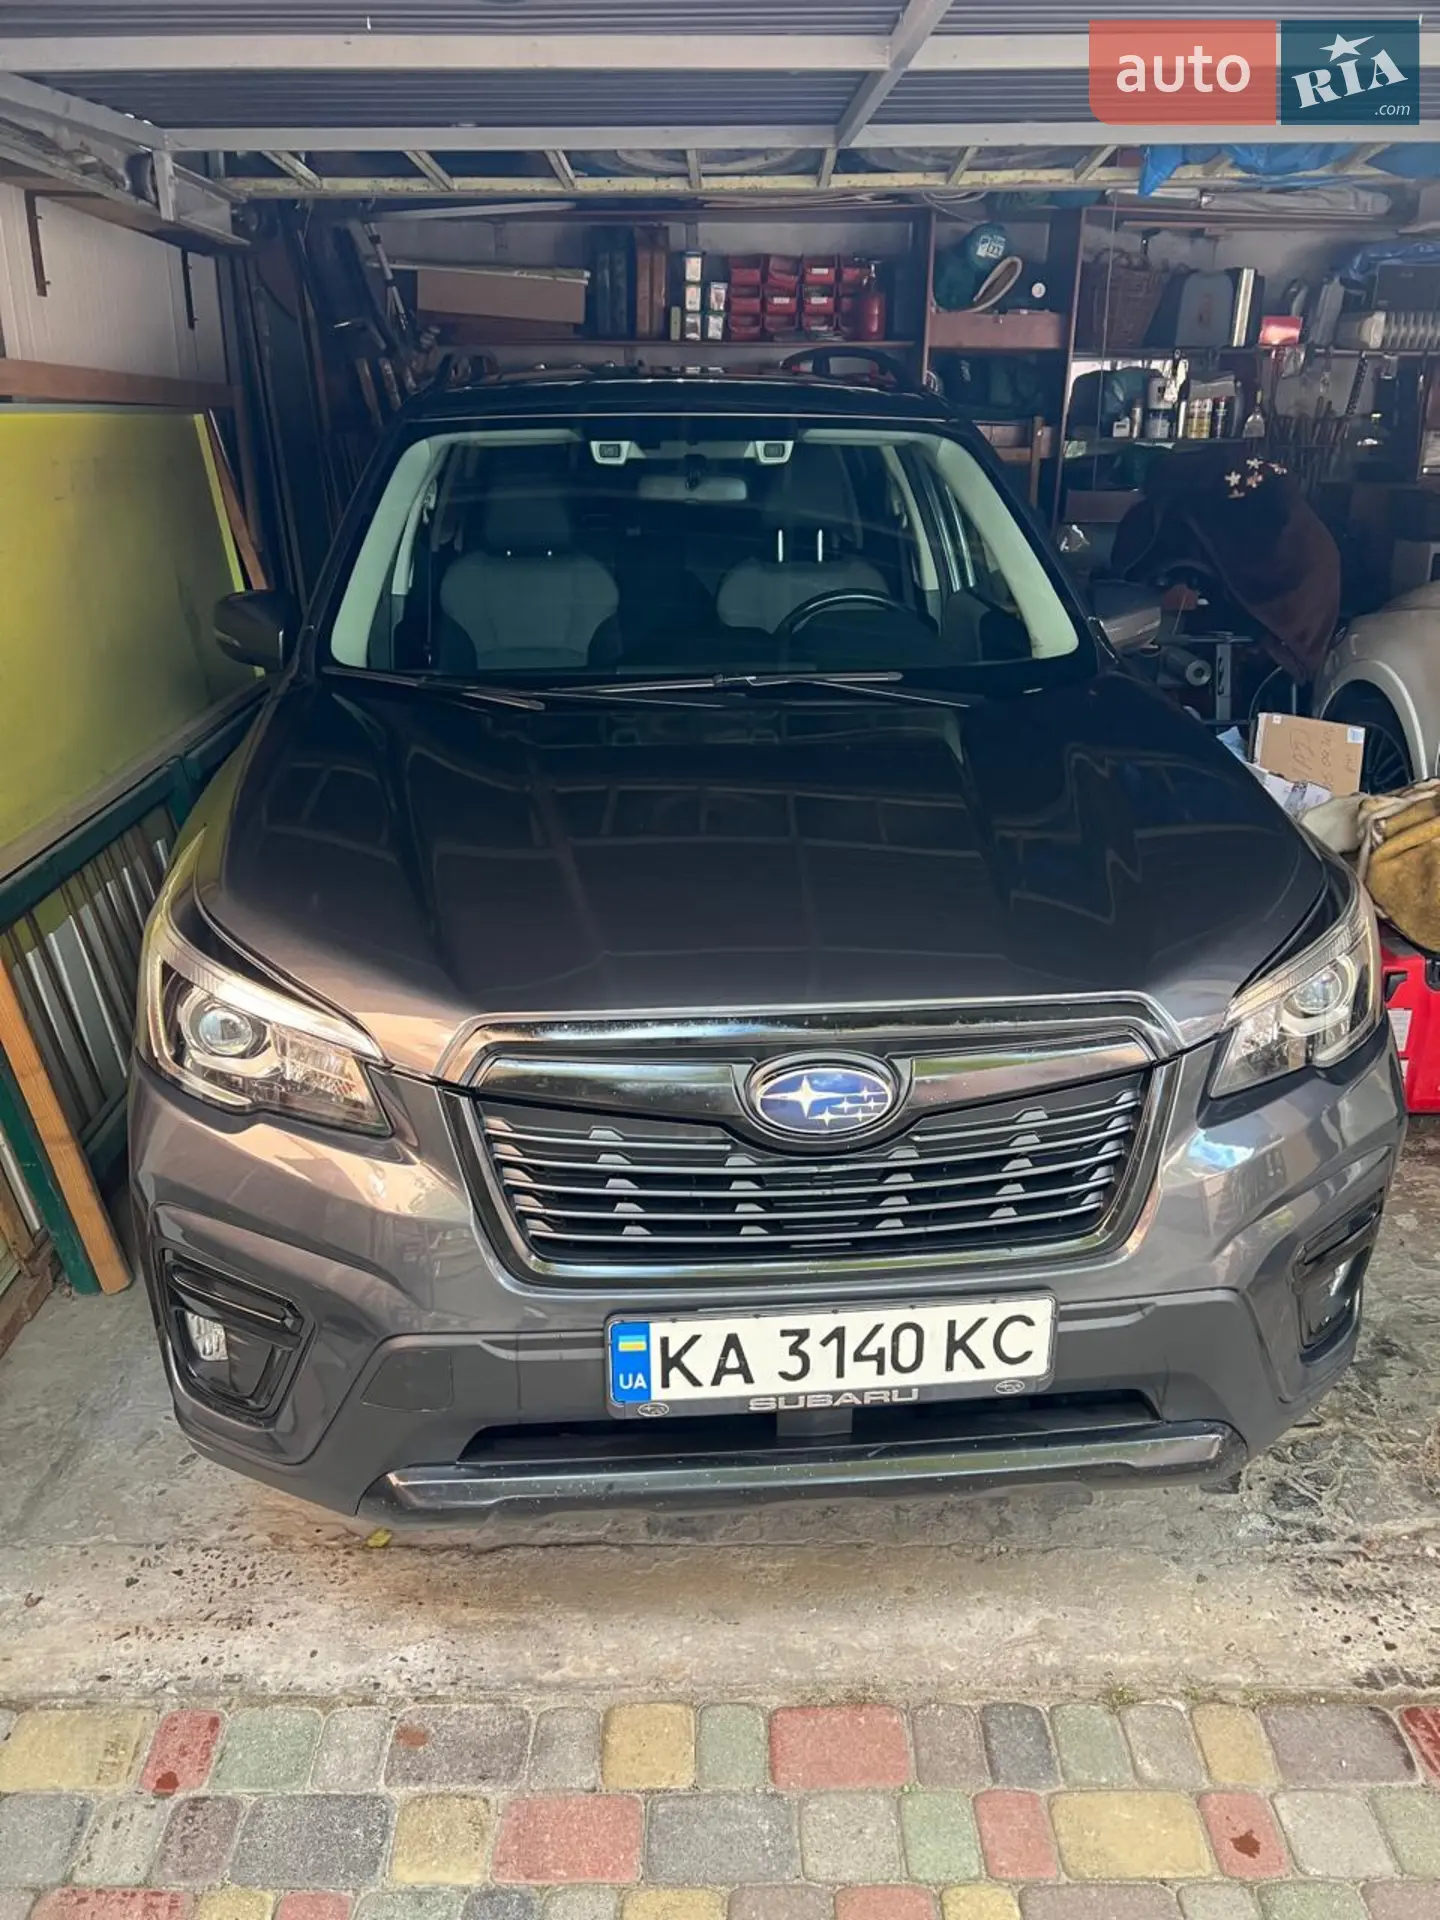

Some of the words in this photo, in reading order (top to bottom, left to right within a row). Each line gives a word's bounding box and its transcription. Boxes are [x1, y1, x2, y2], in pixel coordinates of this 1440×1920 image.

[659, 1332, 755, 1389] KA
[777, 1321, 925, 1382] 3140
[944, 1314, 1036, 1372] KC
[619, 1374, 648, 1390] UA
[747, 1387, 920, 1412] SUBARU
